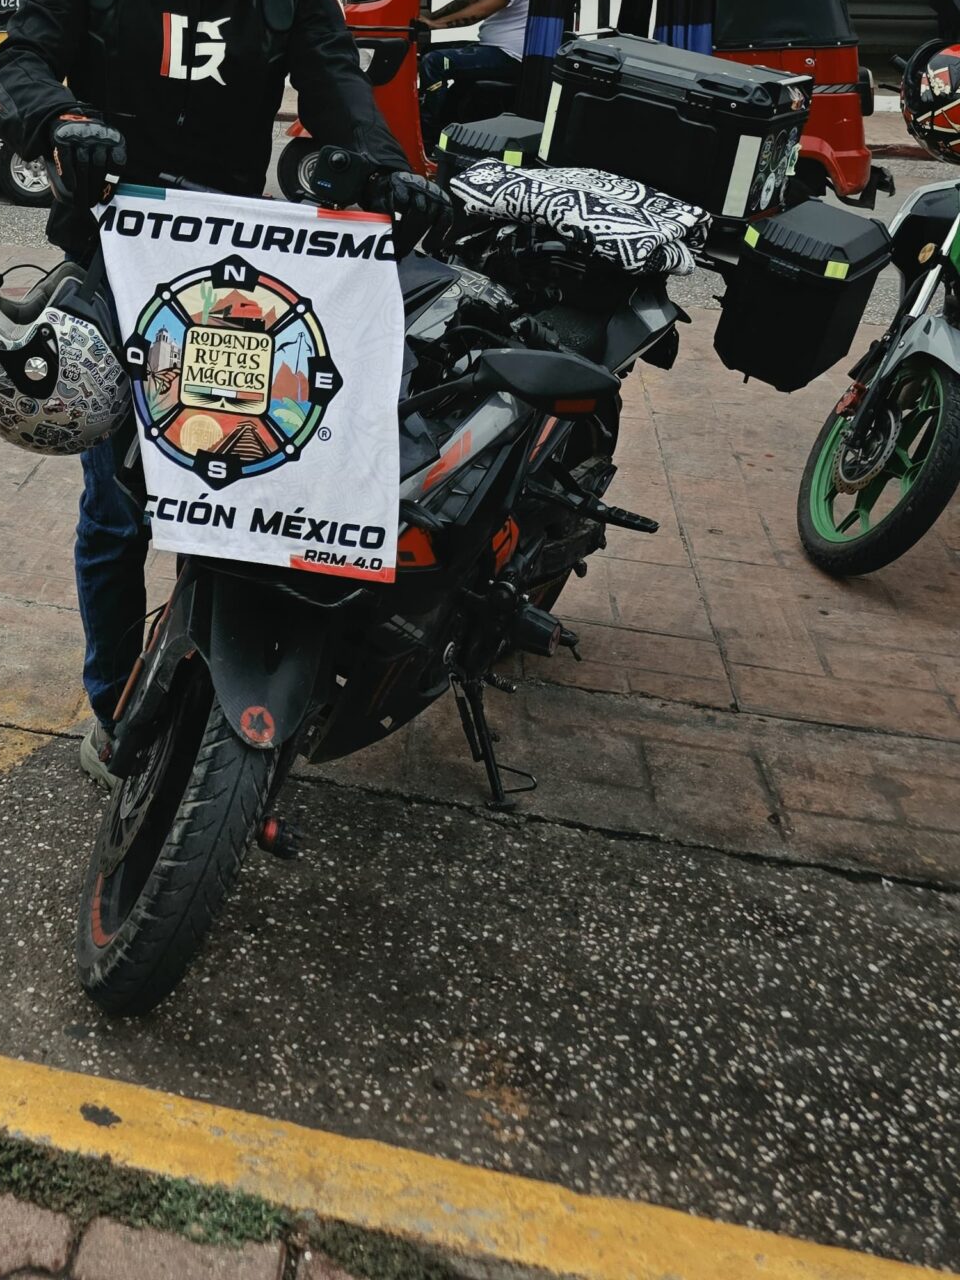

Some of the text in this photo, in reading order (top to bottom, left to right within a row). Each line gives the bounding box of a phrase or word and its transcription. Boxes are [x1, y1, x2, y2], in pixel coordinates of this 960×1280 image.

[223, 265, 246, 282] N
[314, 372, 334, 390] E
[207, 461, 228, 479] S
[249, 507, 386, 550] MÉXICO
[304, 549, 383, 571] RRM 4.0
